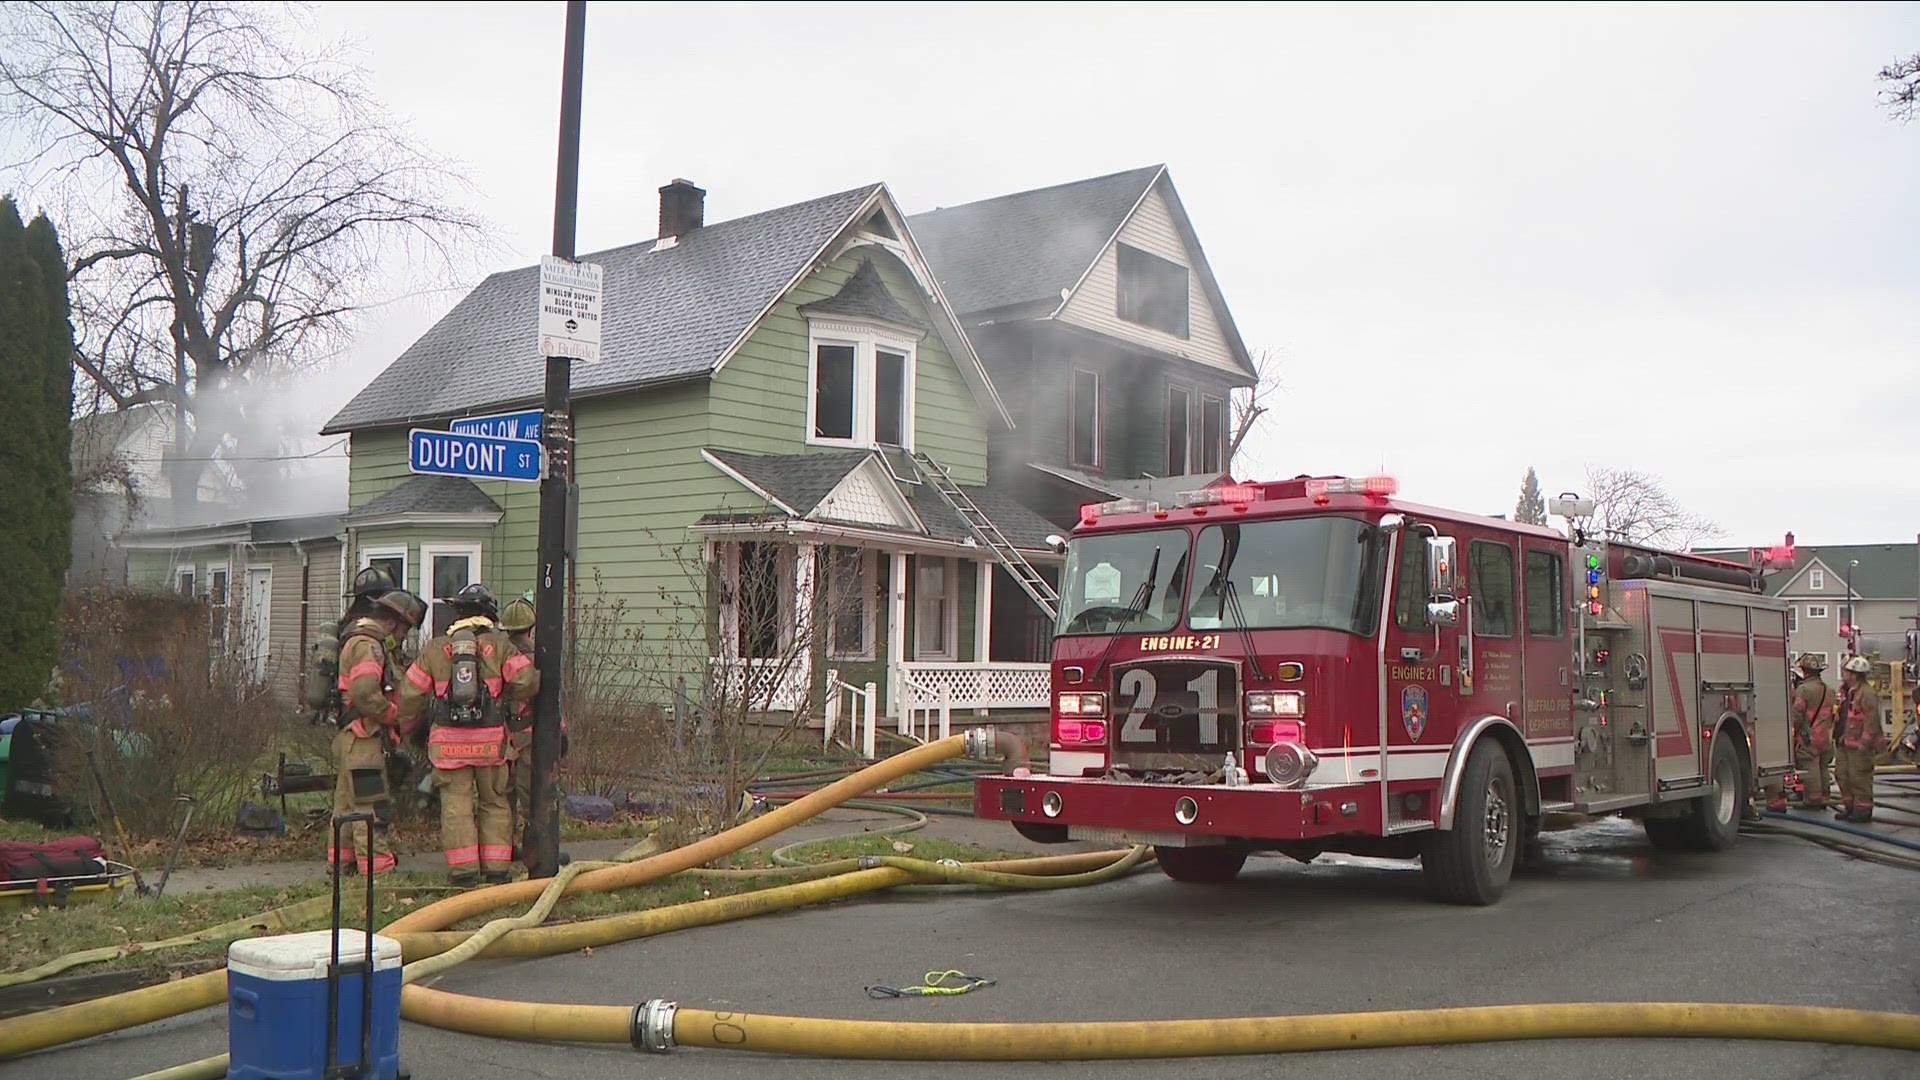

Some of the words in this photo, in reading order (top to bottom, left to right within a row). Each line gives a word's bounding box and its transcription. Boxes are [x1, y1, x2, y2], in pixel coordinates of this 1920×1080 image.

[546, 287, 572, 298] WINSLOW
[574, 292, 596, 303] DUPONT
[555, 298, 572, 308] BLOCK
[574, 302, 588, 311] CLUB
[545, 305, 572, 316] NEIGHBOR
[577, 311, 597, 321] UNITED
[558, 342, 594, 358] Buffalo
[525, 424, 539, 438] AVE
[419, 438, 506, 473] DUPONT
[518, 453, 531, 469] ST
[1140, 636, 1195, 651] ENGINE
[1202, 635, 1220, 649] 21
[1392, 666, 1425, 680] ENGINE
[1427, 668, 1436, 680] 21
[1527, 699, 1556, 713] BUFFALO
[1557, 698, 1570, 712] FIRE
[1529, 718, 1569, 732] DEPARTMENT
